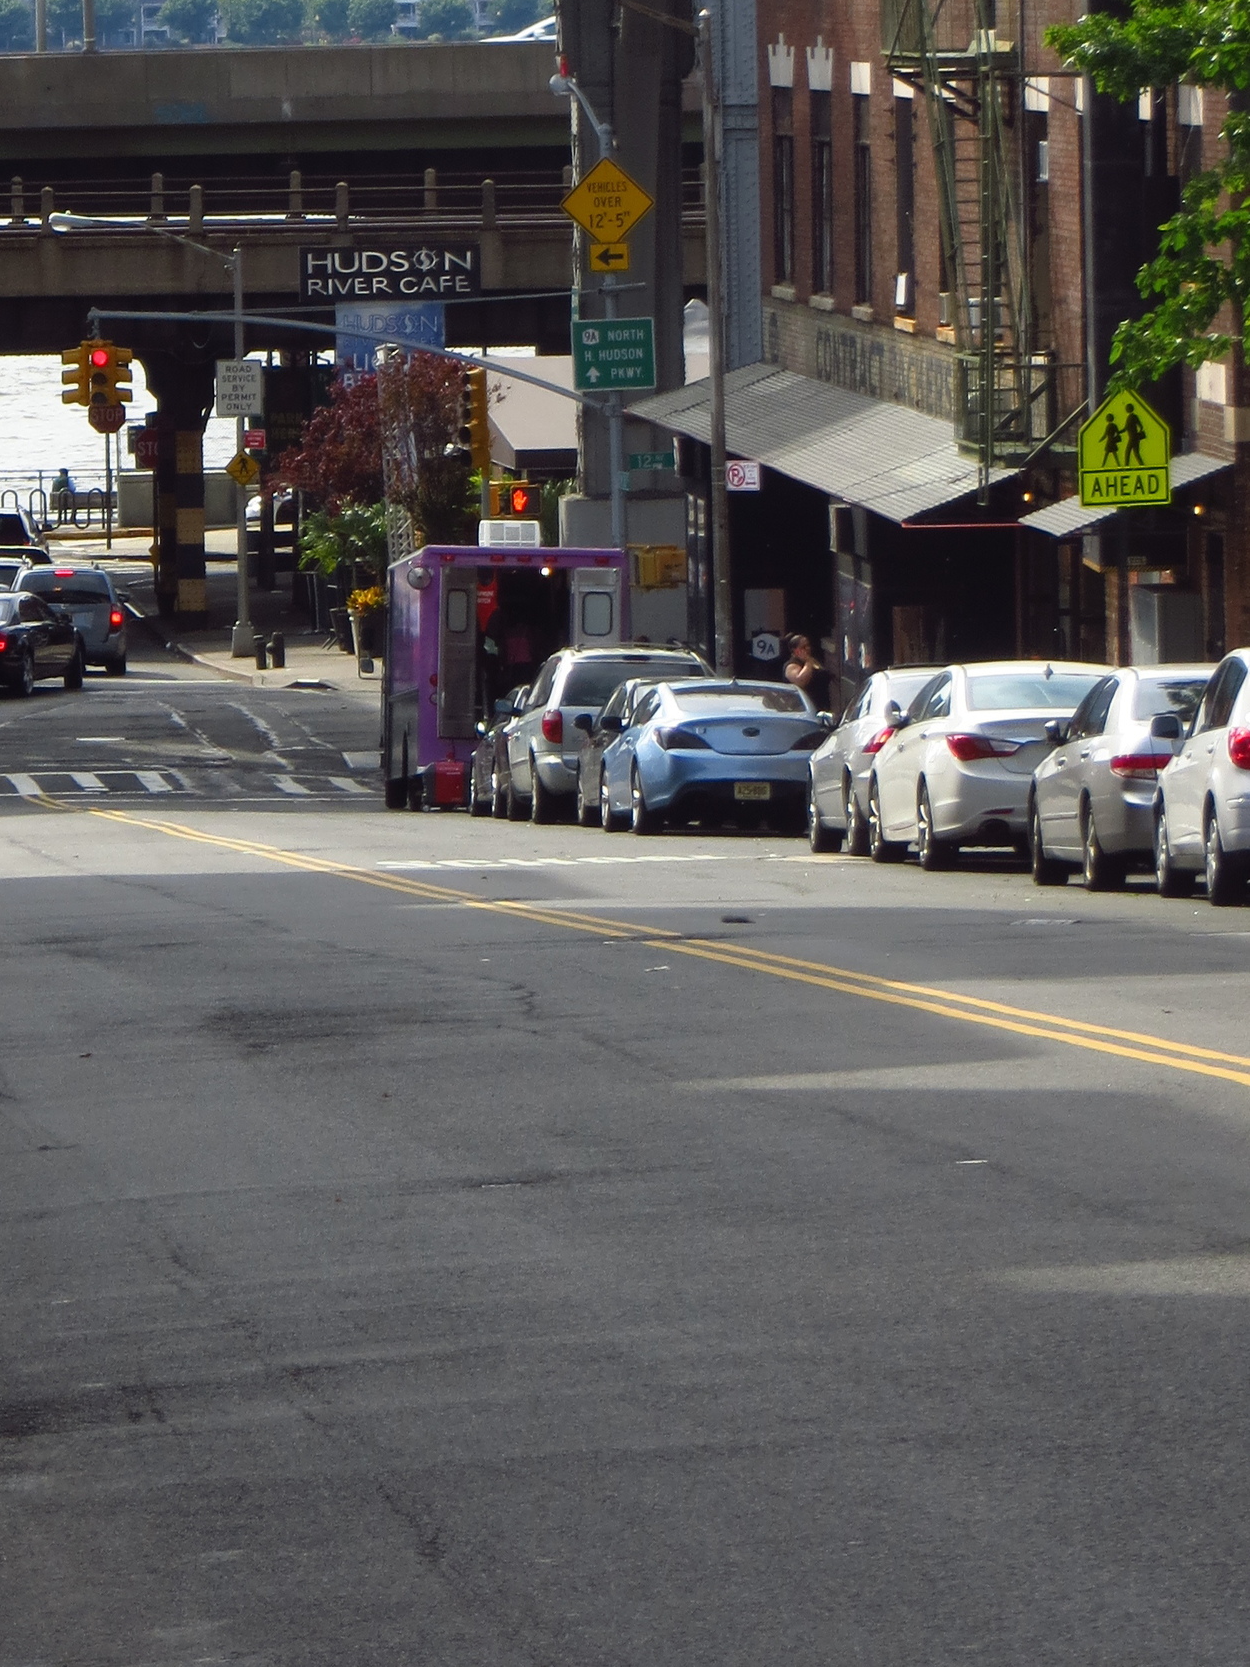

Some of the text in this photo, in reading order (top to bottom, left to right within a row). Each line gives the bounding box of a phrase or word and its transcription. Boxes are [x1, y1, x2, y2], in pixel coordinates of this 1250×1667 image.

[586, 181, 627, 193] VEHICLES
[593, 196, 621, 208] OVER
[307, 246, 472, 274] HUDSON
[307, 275, 471, 296] RIVER CAFE
[342, 313, 438, 334] HUDSON
[607, 329, 644, 341] NORTH
[598, 348, 643, 361] HUDSON
[225, 365, 252, 373] ROAD
[222, 375, 256, 383] SERVICE
[92, 408, 124, 422] STOP
[1091, 474, 1160, 497] AHEAD
[756, 639, 775, 655] 9A
